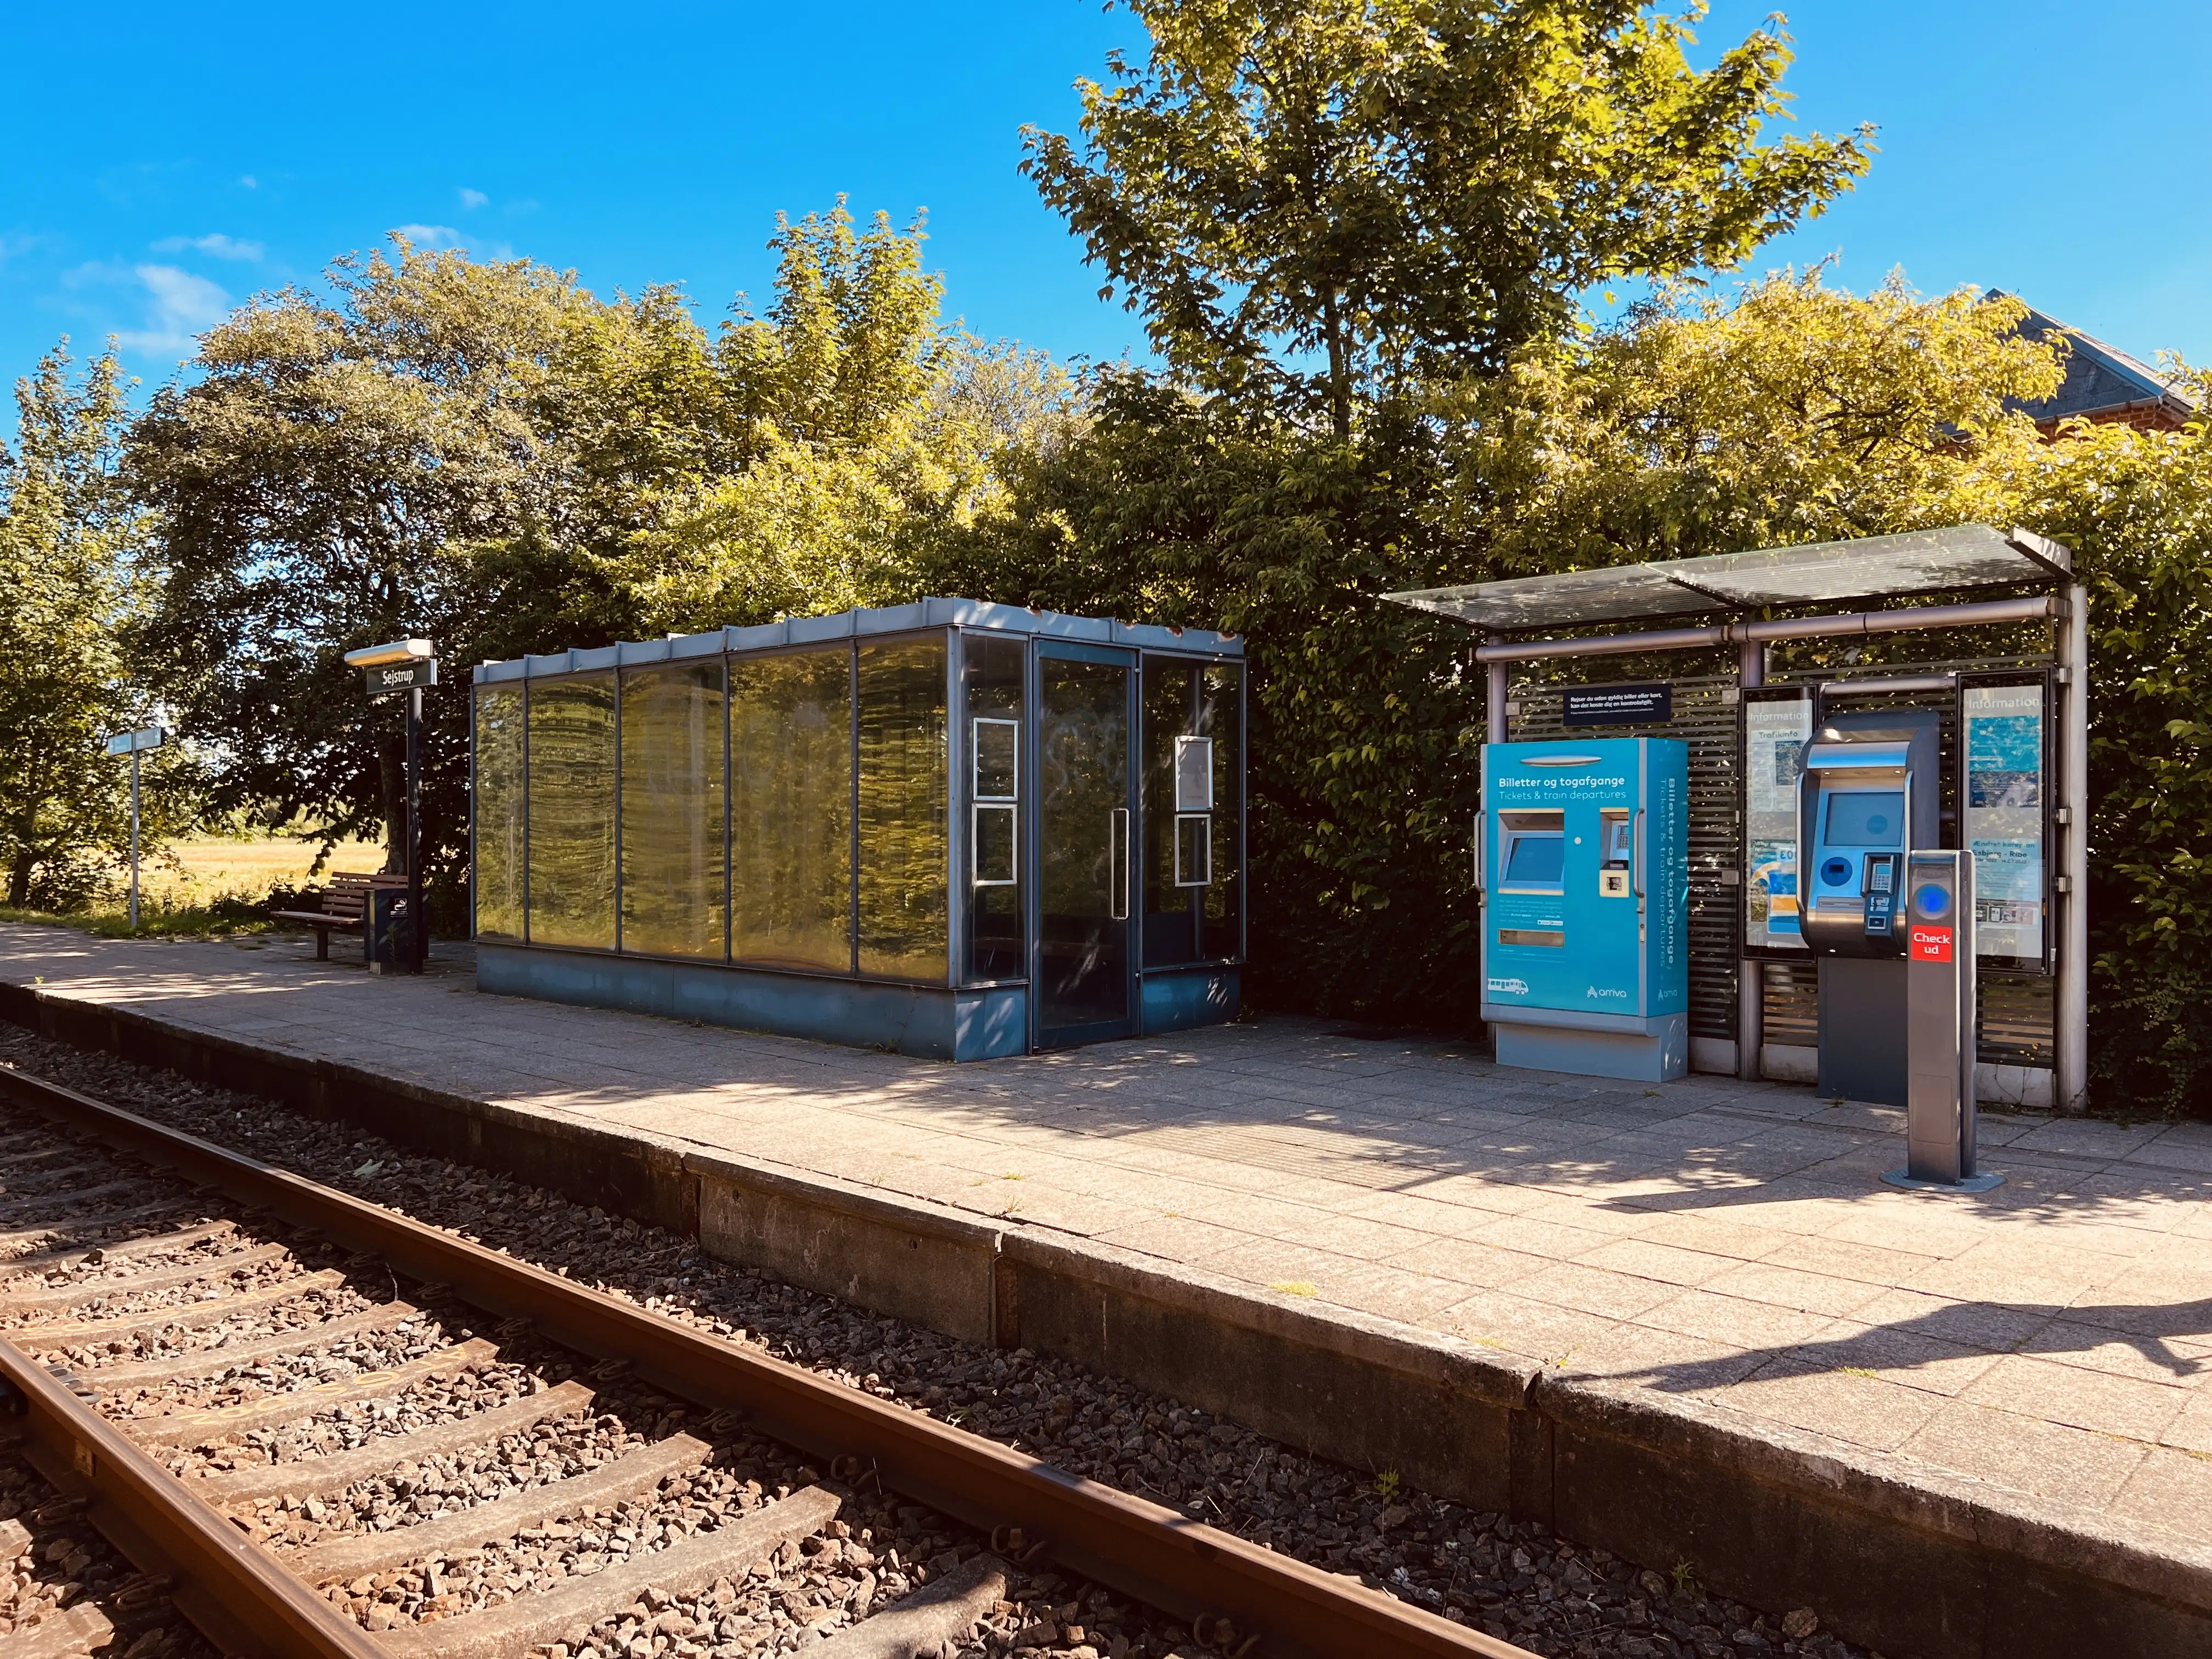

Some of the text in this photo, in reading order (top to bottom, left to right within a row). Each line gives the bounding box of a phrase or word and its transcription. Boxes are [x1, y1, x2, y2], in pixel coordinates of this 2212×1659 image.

[383, 669, 414, 686] Sejstrup
[1968, 696, 2039, 709] Information
[1750, 711, 1809, 721] Information
[1759, 730, 1798, 738] Trafikinfo
[1499, 776, 1625, 788] Billetter og togafgange
[1499, 790, 1626, 800] Tickets & train departures
[1660, 833, 1666, 842] &
[1667, 847, 1673, 866] og
[1914, 932, 1950, 944] Check
[1923, 945, 1939, 955] ud
[1599, 988, 1627, 998] arriva
